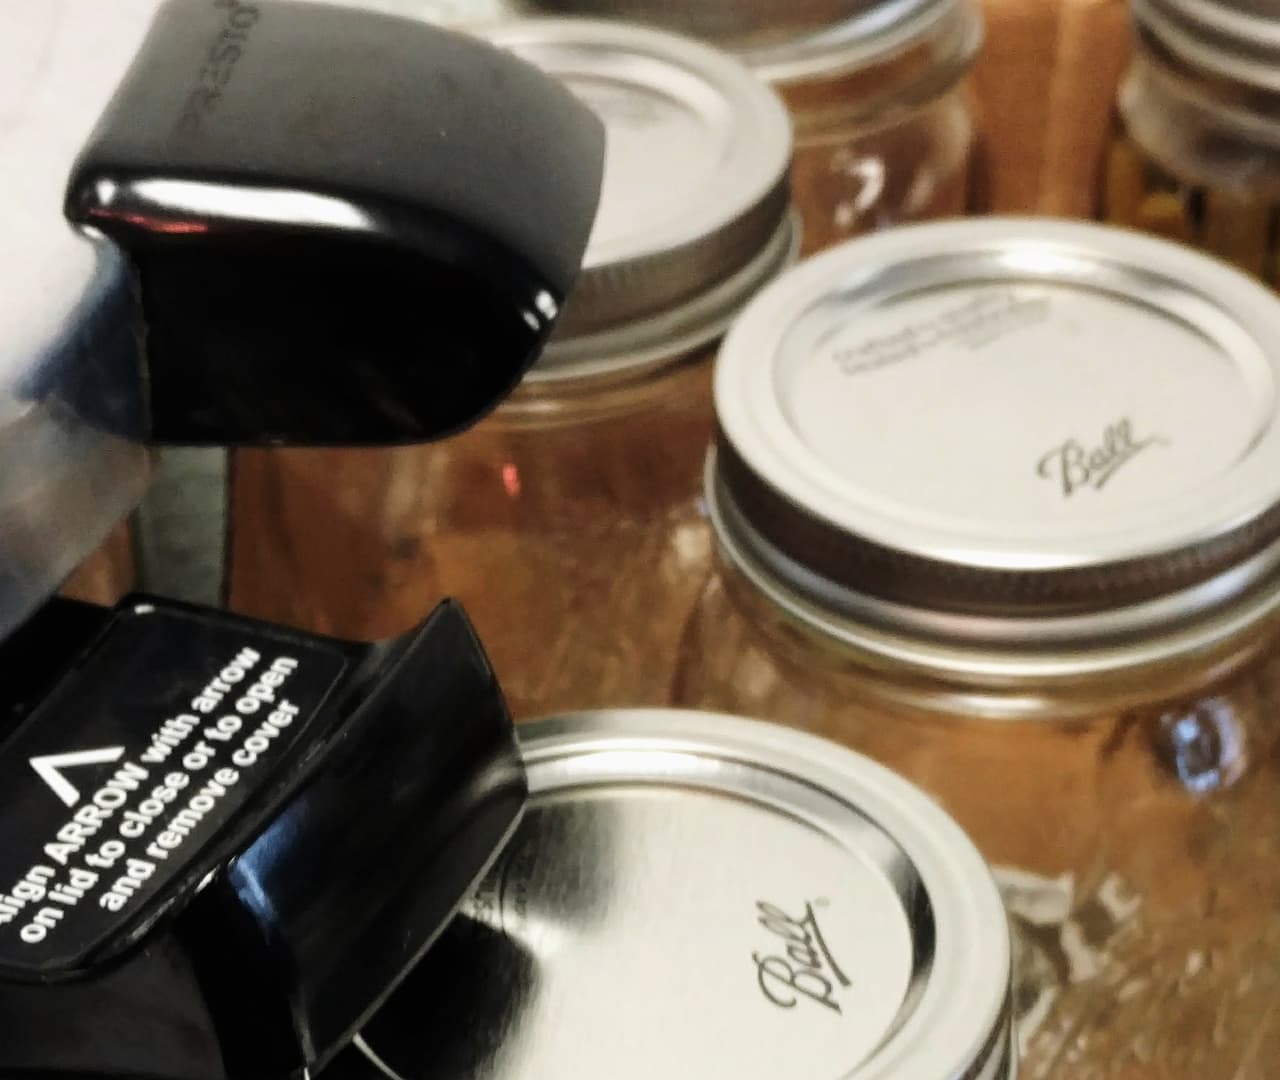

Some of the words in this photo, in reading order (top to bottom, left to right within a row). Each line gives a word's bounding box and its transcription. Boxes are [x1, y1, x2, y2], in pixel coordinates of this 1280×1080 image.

[1036, 416, 1168, 498] Ball
[20, 904, 64, 943] on
[48, 867, 99, 906] lid
[85, 839, 125, 869] to
[120, 771, 190, 838] close
[183, 740, 217, 770] or
[204, 714, 242, 742] to
[236, 655, 299, 714] open
[44, 761, 149, 865] ARROW
[141, 712, 200, 763] with
[191, 646, 261, 713] arrow
[99, 858, 156, 912] and
[147, 766, 239, 859] remove
[232, 699, 300, 767] cover
[752, 900, 852, 1016] Ball
